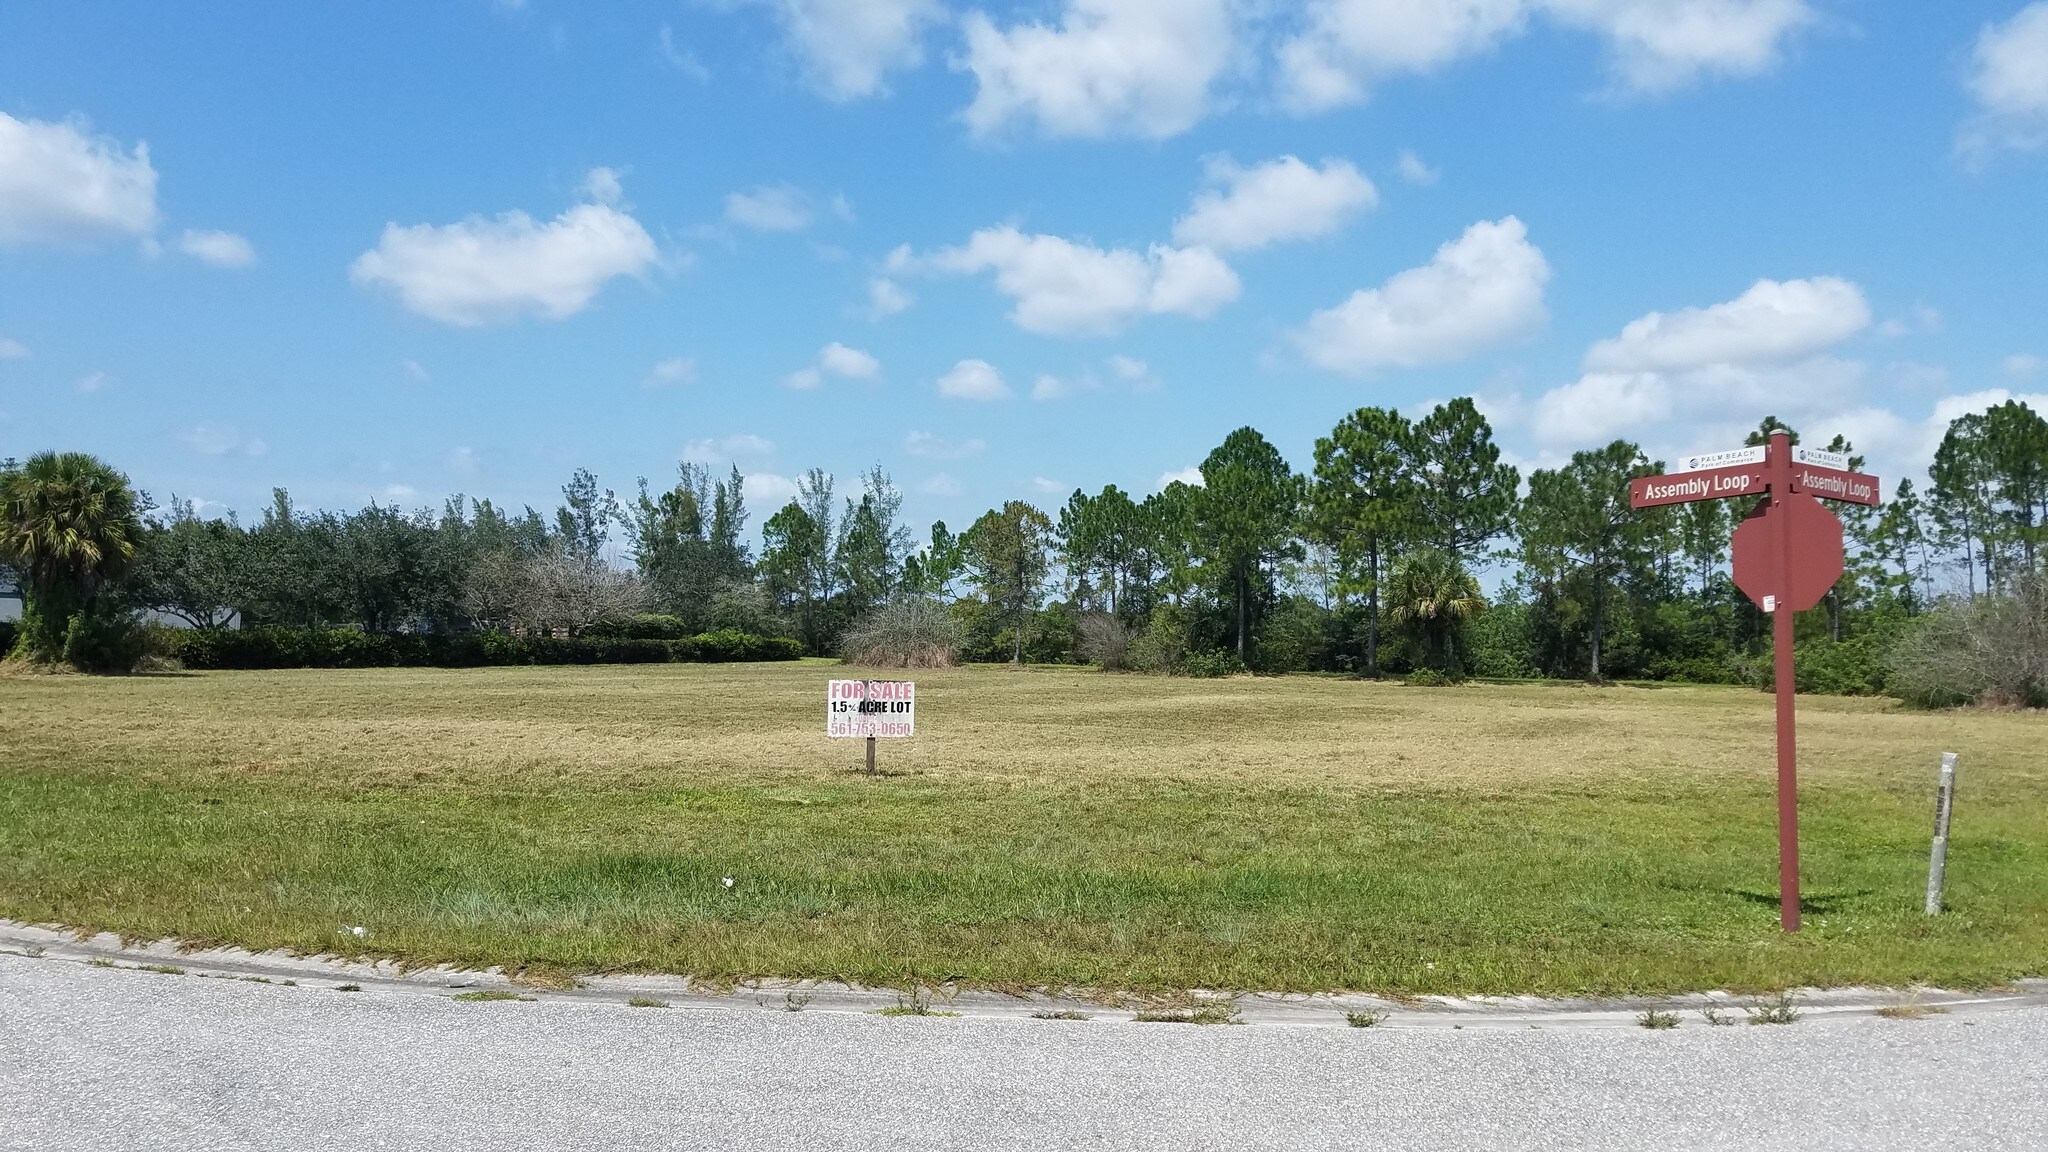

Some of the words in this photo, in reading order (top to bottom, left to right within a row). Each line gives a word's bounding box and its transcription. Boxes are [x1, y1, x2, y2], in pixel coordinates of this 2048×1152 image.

[1701, 454, 1723, 463] PALM
[1726, 450, 1755, 459] BEACH
[1807, 451, 1822, 459] PALM
[1823, 454, 1842, 462] BEACH
[1645, 477, 1710, 500] Assembly
[1714, 474, 1750, 492] Loop
[1802, 470, 1847, 497] Assembly
[1849, 479, 1871, 501] Loop
[831, 682, 864, 699] FOR
[870, 683, 911, 700] SALE
[858, 701, 888, 713] ACRE
[890, 701, 911, 713] LOT
[831, 722, 911, 735] 561-753-0650
